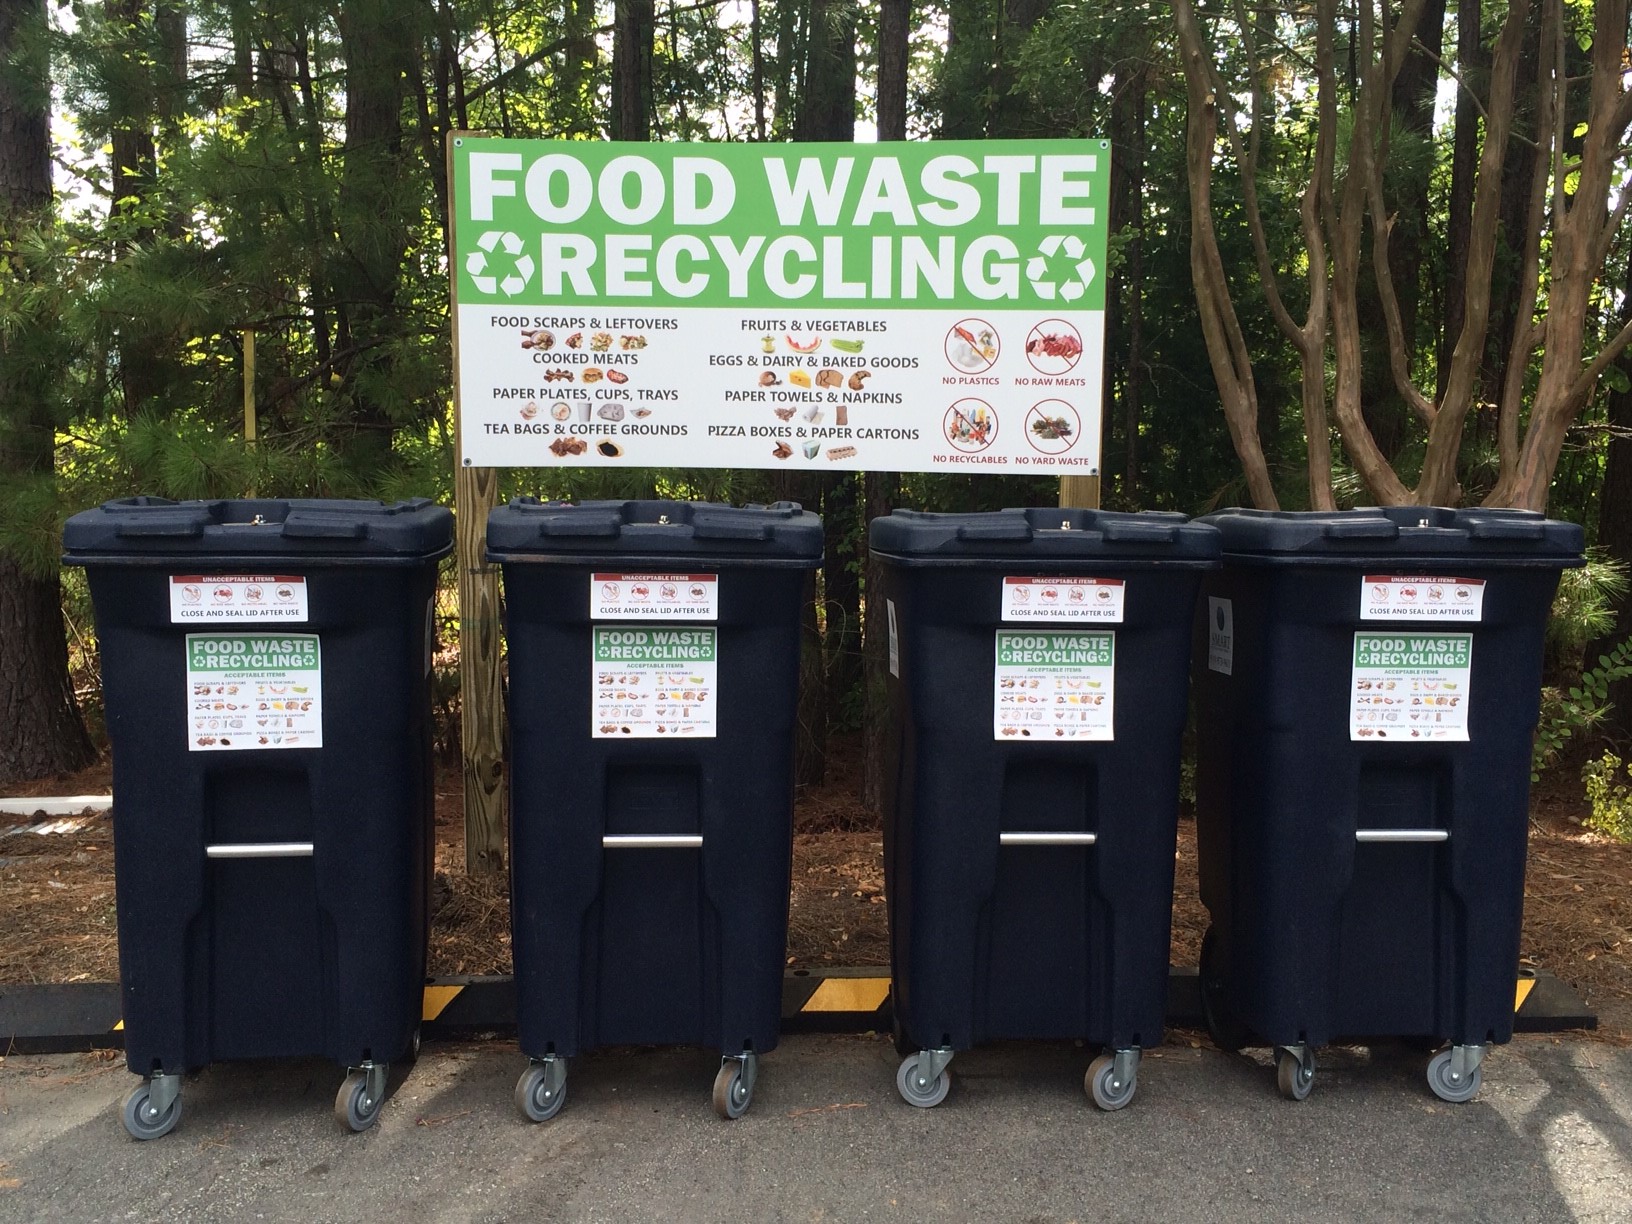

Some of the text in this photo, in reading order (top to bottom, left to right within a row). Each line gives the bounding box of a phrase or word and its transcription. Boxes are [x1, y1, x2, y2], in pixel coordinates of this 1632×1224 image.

[469, 152, 1097, 226] FOOD WASTE
[541, 233, 1019, 300] RECYCLING
[491, 316, 679, 330] FOOD SCRAPS & LEFTOVERS
[742, 320, 886, 331] FRUITS & VEGETABLES
[533, 353, 638, 364] COOKED MEATS
[710, 355, 918, 368] EGGS & DAIRY & BAKED GOODS
[959, 377, 999, 385] PLASTICS
[493, 388, 678, 401] PAPER PLATES, CUPS, TRAYS
[726, 391, 902, 403] PAPER TOWELS & NAPKINS
[484, 424, 687, 435] TEA BAGS & COFFEE GROUNDS
[709, 426, 919, 439] PIZZA BOXES & PAPER CARTONS
[599, 632, 712, 645] FOOD WASTE
[1002, 637, 1109, 650] FOOD WASTE
[194, 640, 314, 654] FOOD WASTE
[611, 646, 699, 658] RECYCLING
[1360, 639, 1466, 652] FOOD WASTE
[207, 655, 302, 668] RECYCLING
[1013, 651, 1097, 663] RECYCLING
[1370, 653, 1454, 665] RECYCLING
